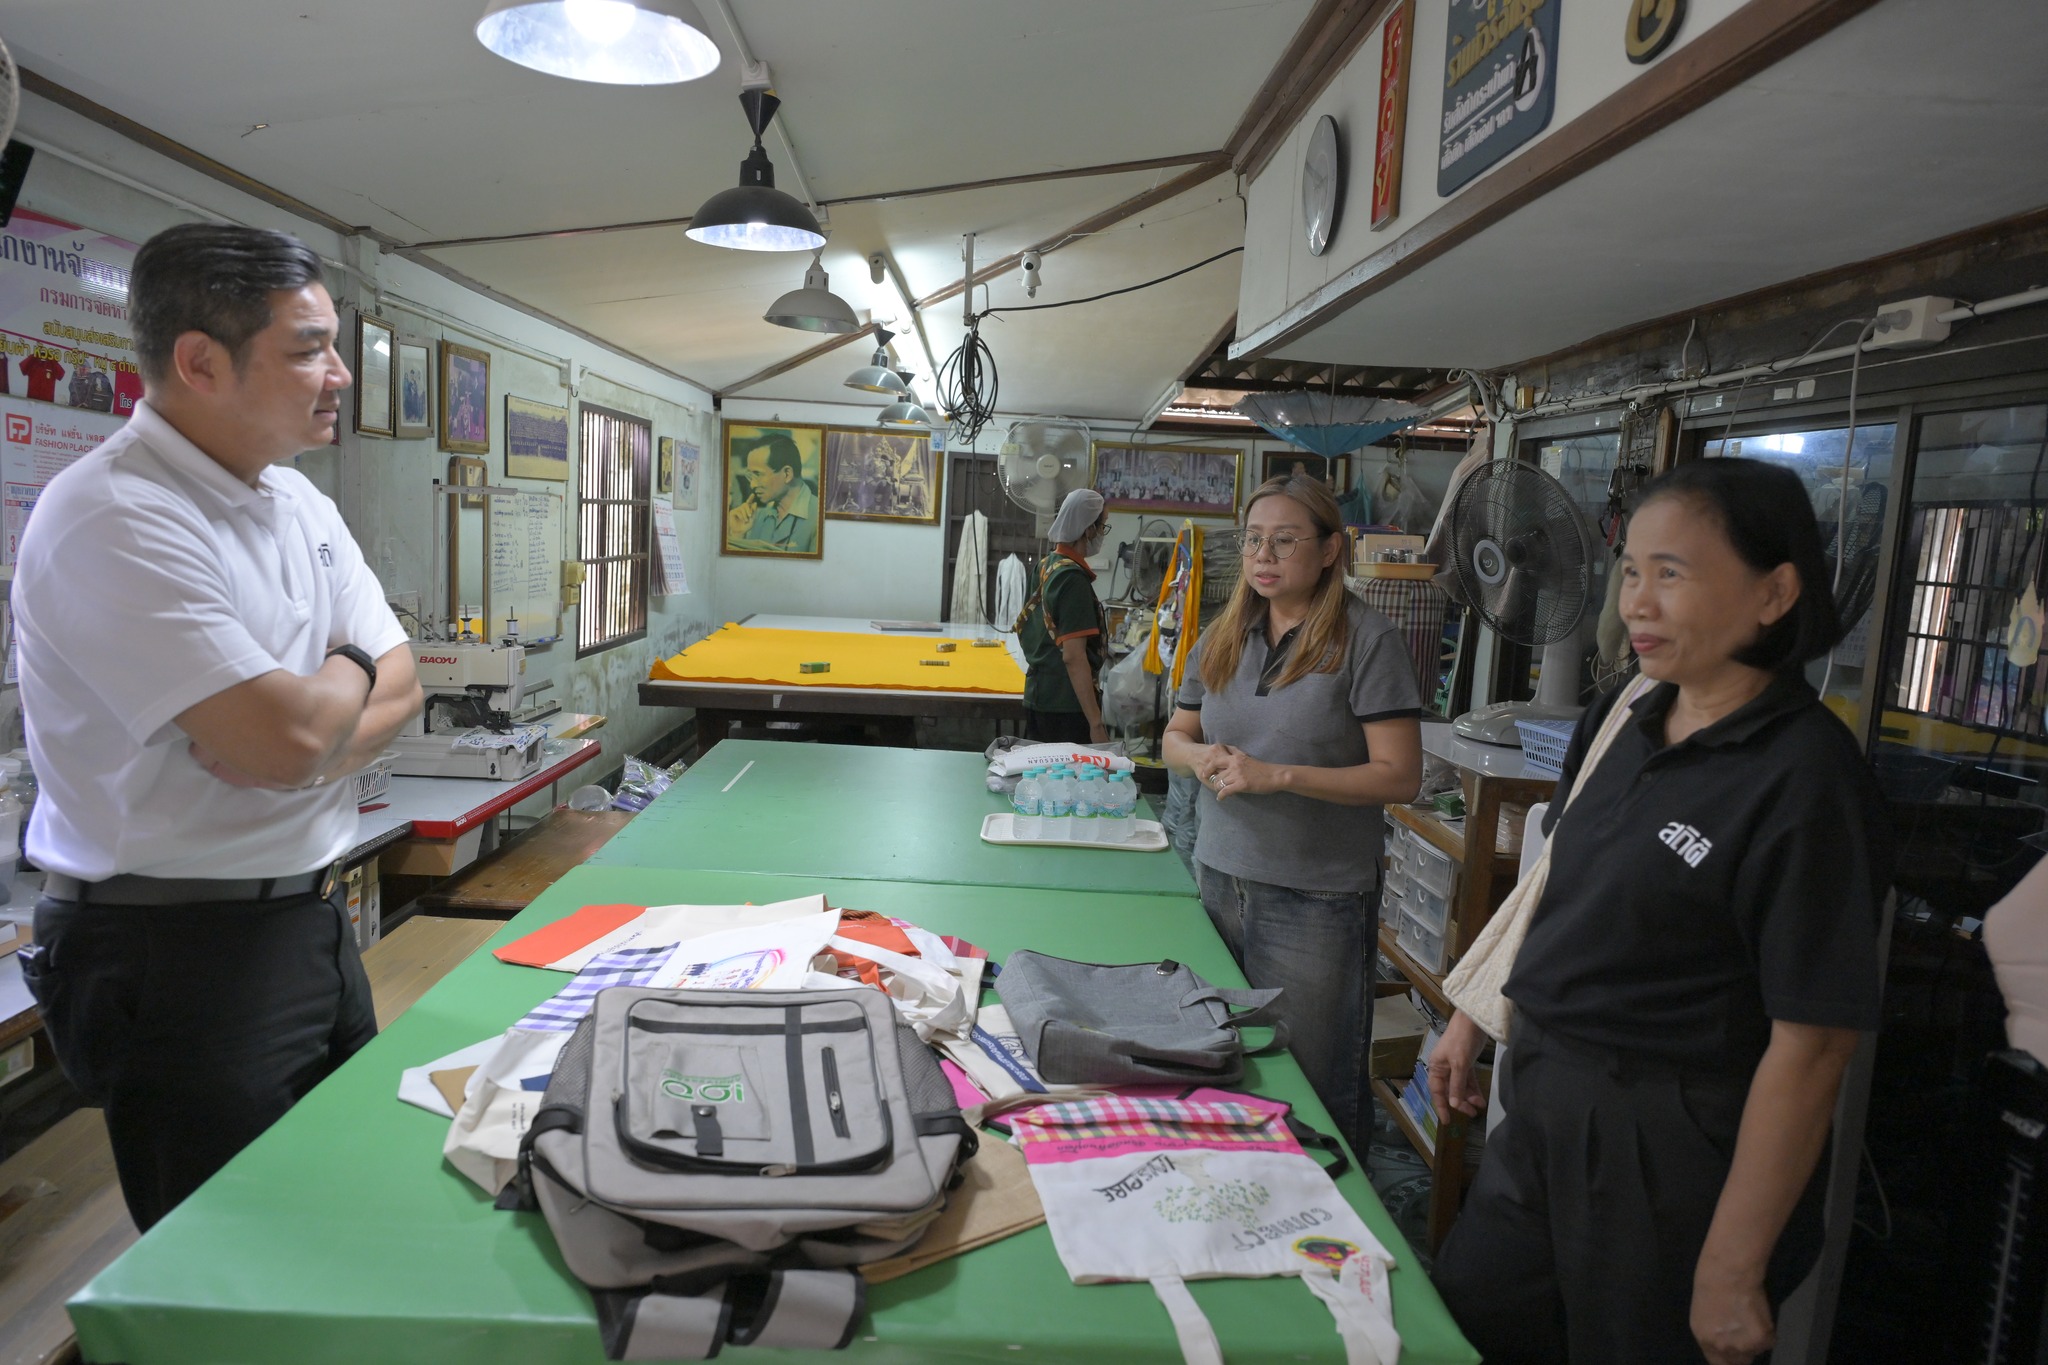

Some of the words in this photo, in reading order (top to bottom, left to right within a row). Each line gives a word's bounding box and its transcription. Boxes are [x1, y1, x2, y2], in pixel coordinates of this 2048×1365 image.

[43, 319, 137, 352] สนับสนุนส่งเสริมกา
[118, 356, 140, 375] ตำบ
[35, 438, 68, 450] FASHION
[419, 656, 457, 664] BAOYU
[1099, 1154, 1176, 1203] INSPIRE
[1232, 1207, 1333, 1252] CONNECT
